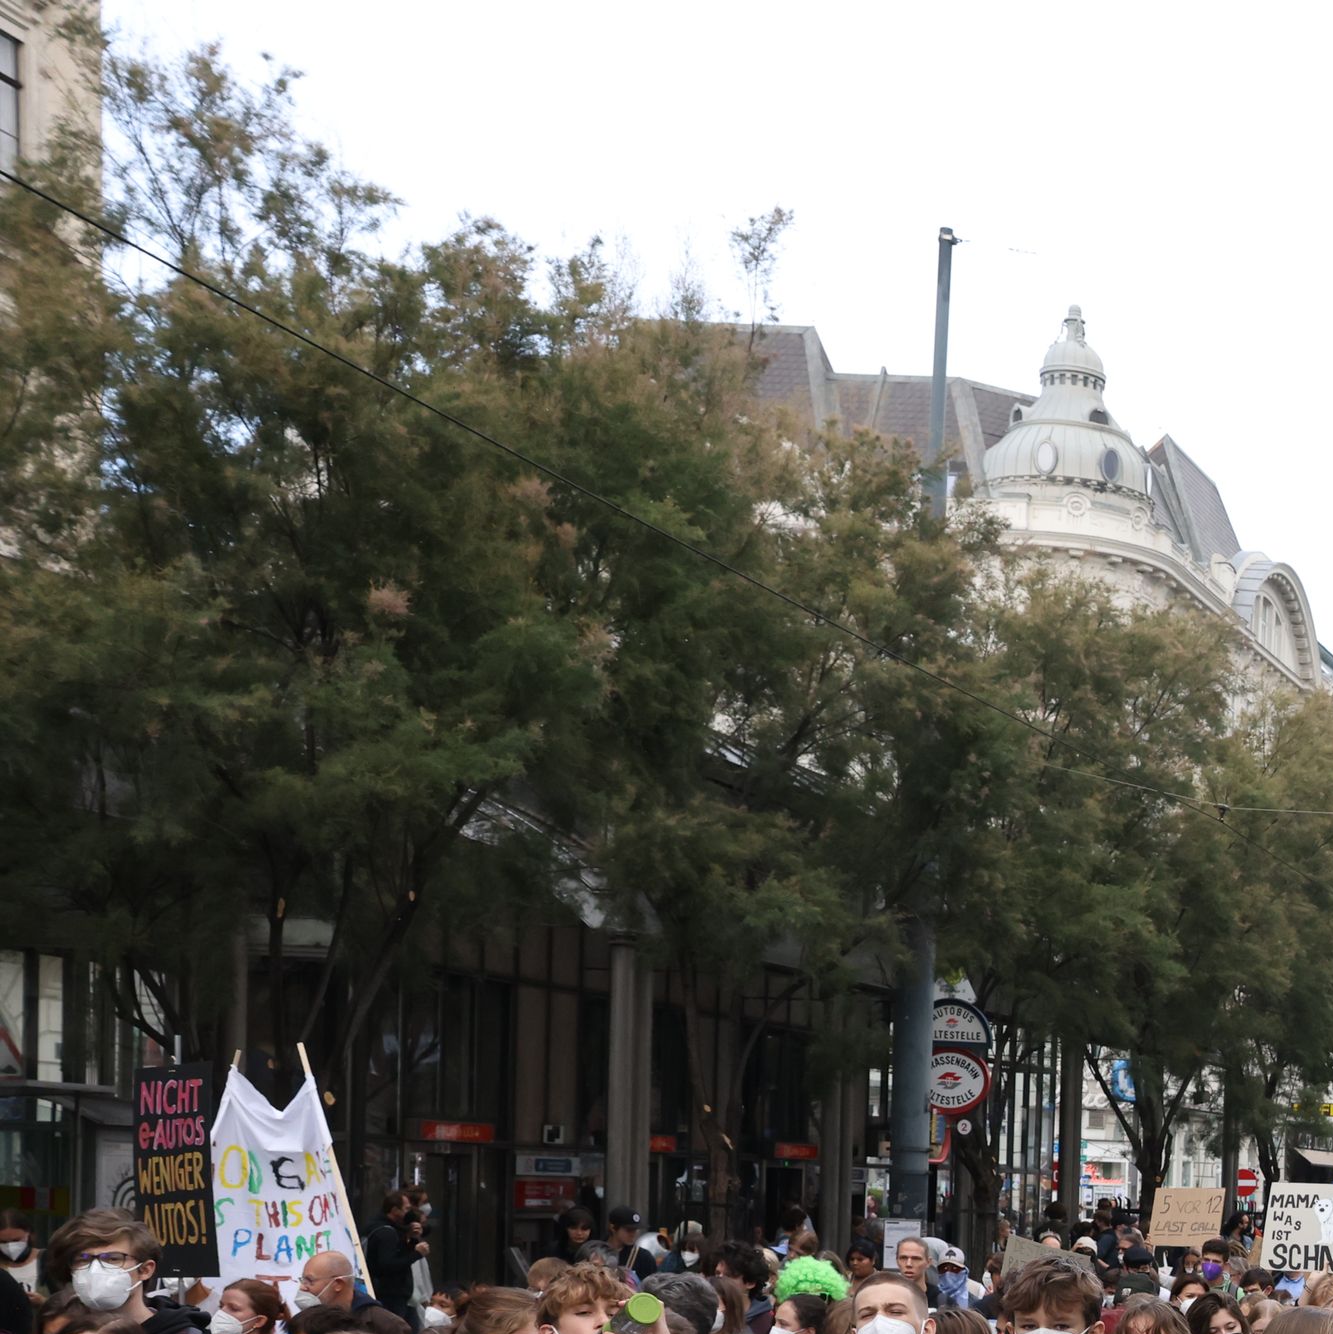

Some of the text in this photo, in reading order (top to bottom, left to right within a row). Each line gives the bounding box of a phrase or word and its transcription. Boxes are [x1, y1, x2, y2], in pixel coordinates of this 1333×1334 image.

[934, 1030, 981, 1042] LTESTELLE
[931, 1055, 980, 1080] RASSENBAHN
[139, 1078, 203, 1115] NICHT
[929, 1089, 976, 1106] LTESTELLE
[961, 1121, 969, 1132] 2
[138, 1151, 205, 1195] WENIGER
[1160, 1195, 1223, 1215] 5 VOR 12
[1270, 1194, 1320, 1209] MAMA
[246, 1199, 303, 1229] THIS
[1273, 1211, 1302, 1231] WAS
[1154, 1220, 1218, 1233] LAST CALL
[1272, 1230, 1292, 1241] IST
